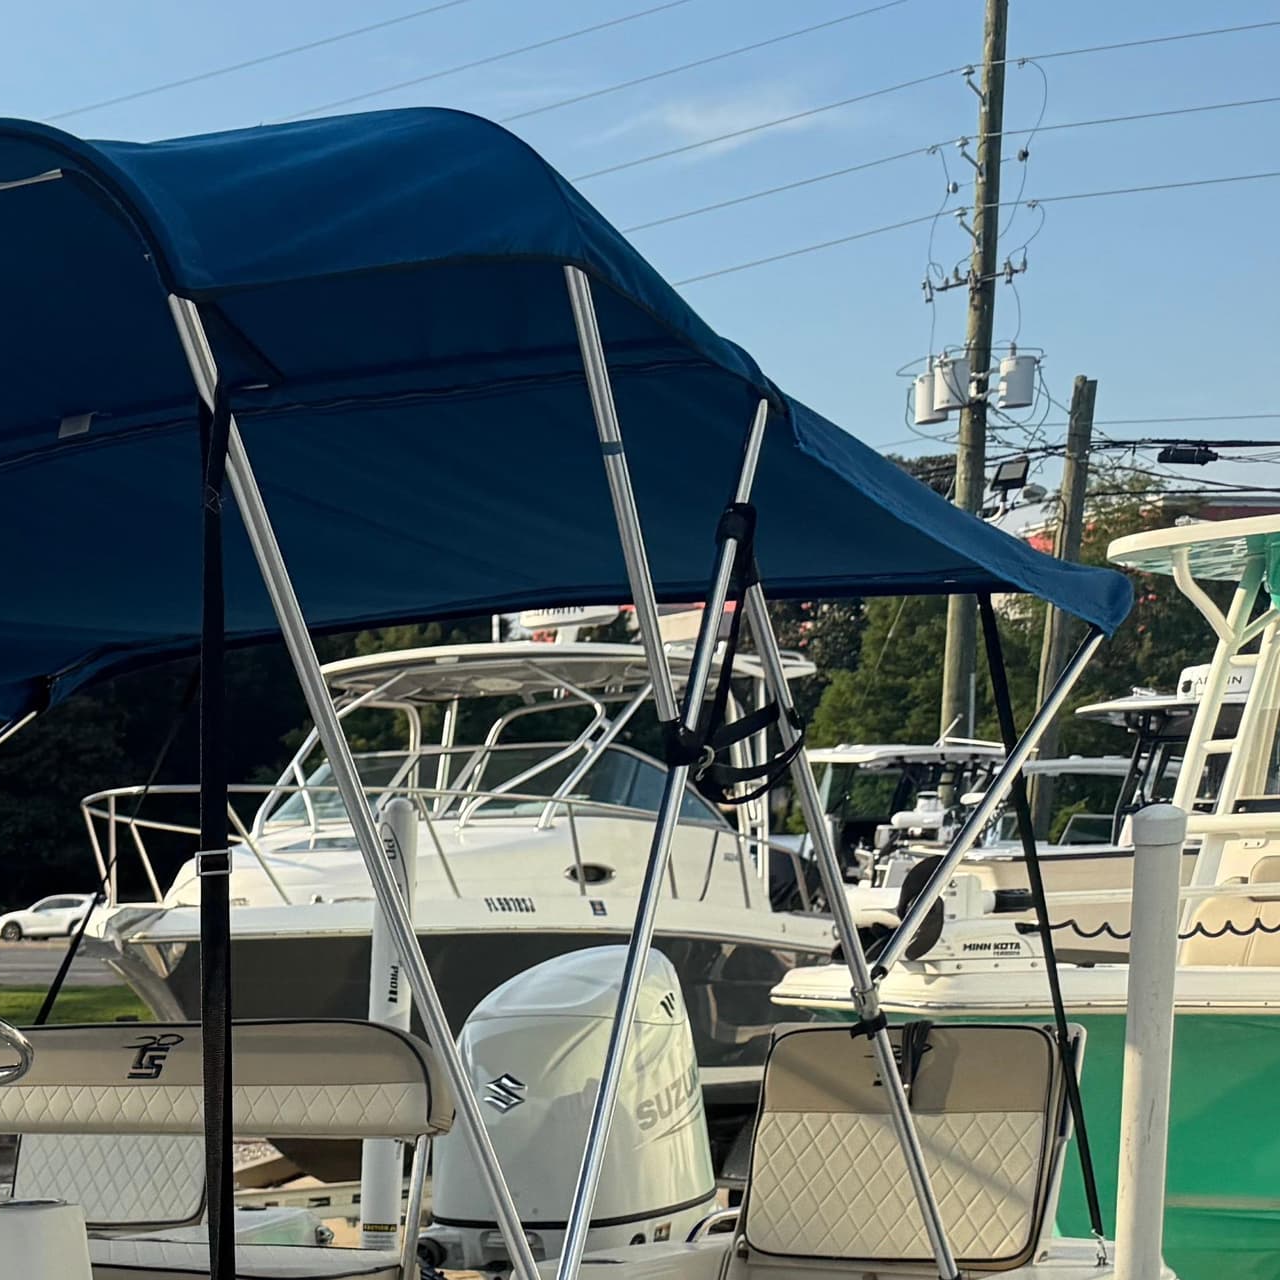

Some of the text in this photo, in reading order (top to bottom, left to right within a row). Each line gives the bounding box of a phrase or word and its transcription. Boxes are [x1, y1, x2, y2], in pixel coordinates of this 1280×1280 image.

[963, 942, 1021, 951] MINN KOTA
[636, 1065, 698, 1131] SUZU
